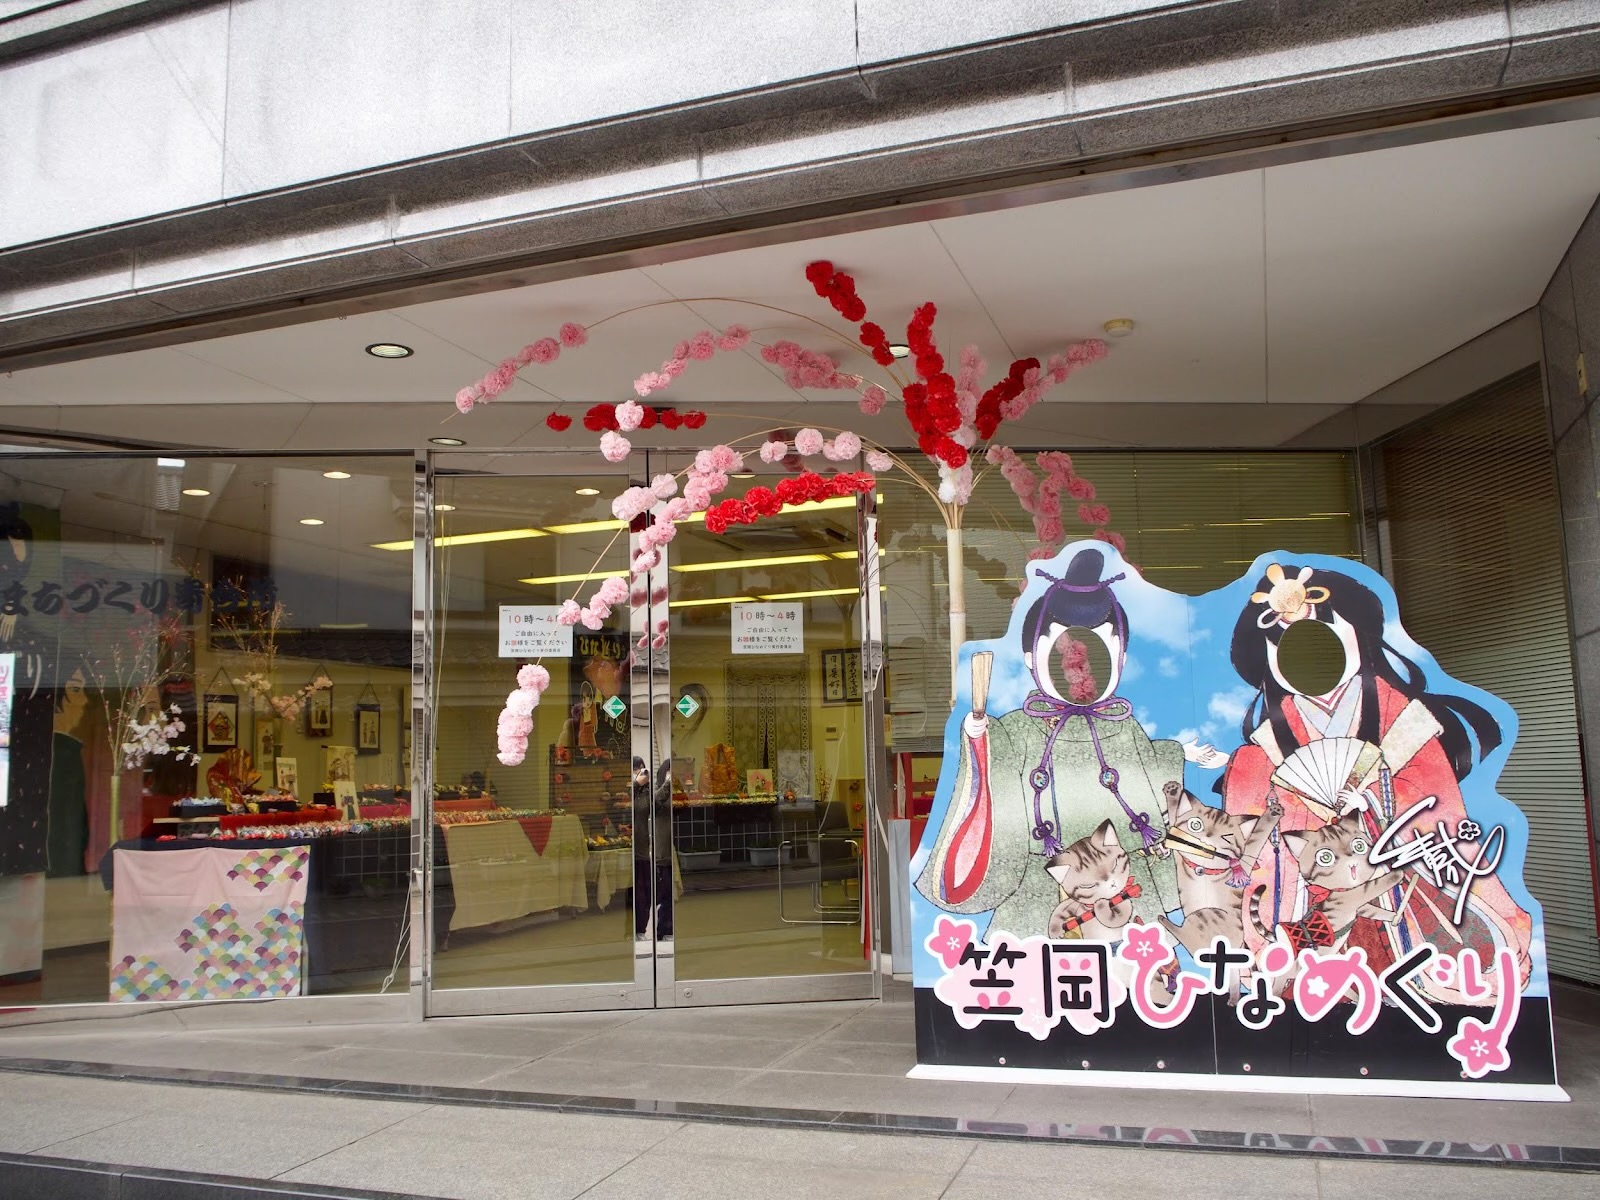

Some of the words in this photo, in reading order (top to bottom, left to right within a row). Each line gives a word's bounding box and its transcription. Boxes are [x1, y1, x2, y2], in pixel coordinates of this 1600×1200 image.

[0, 576, 279, 616] まちづくり
[508, 614, 559, 624] 10時～4
[948, 922, 1520, 1074] 笠岡ひなめぐり
